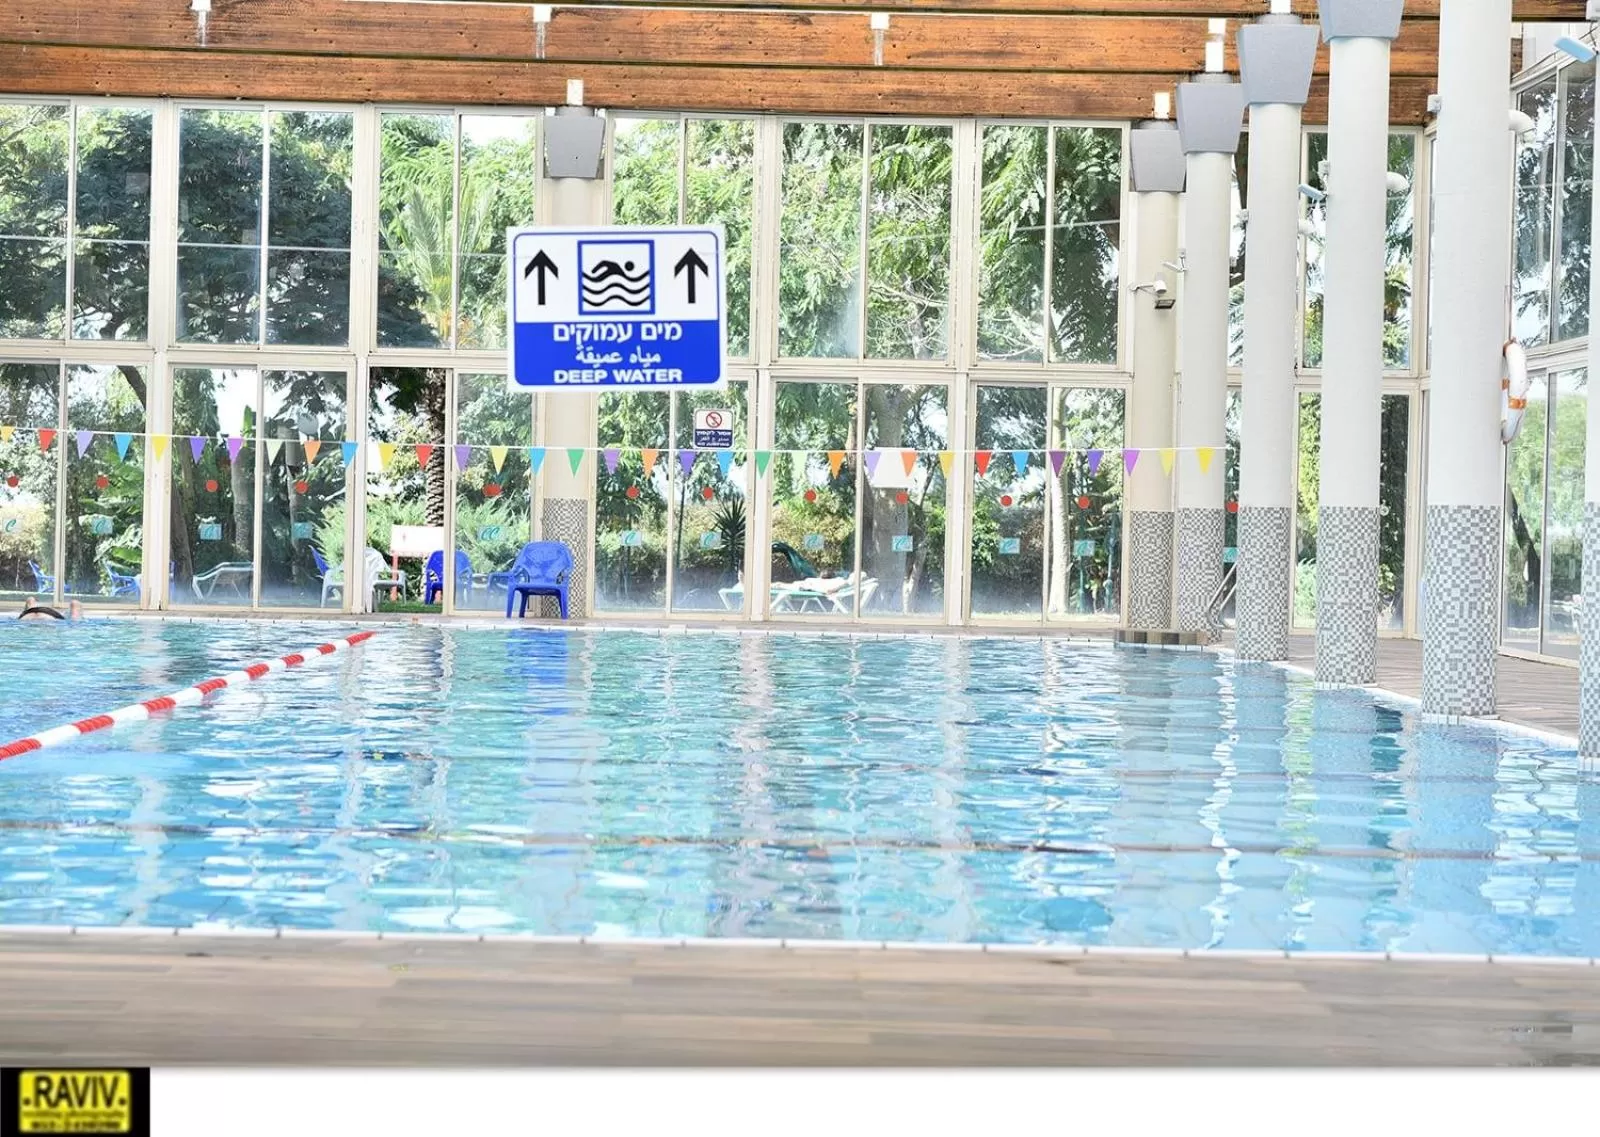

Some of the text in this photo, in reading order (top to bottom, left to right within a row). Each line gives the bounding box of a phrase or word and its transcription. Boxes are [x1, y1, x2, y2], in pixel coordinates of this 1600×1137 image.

[553, 322, 683, 346] מים עמוקים
[575, 344, 662, 369] مياه عميقة
[553, 368, 683, 384] DEEP WATER
